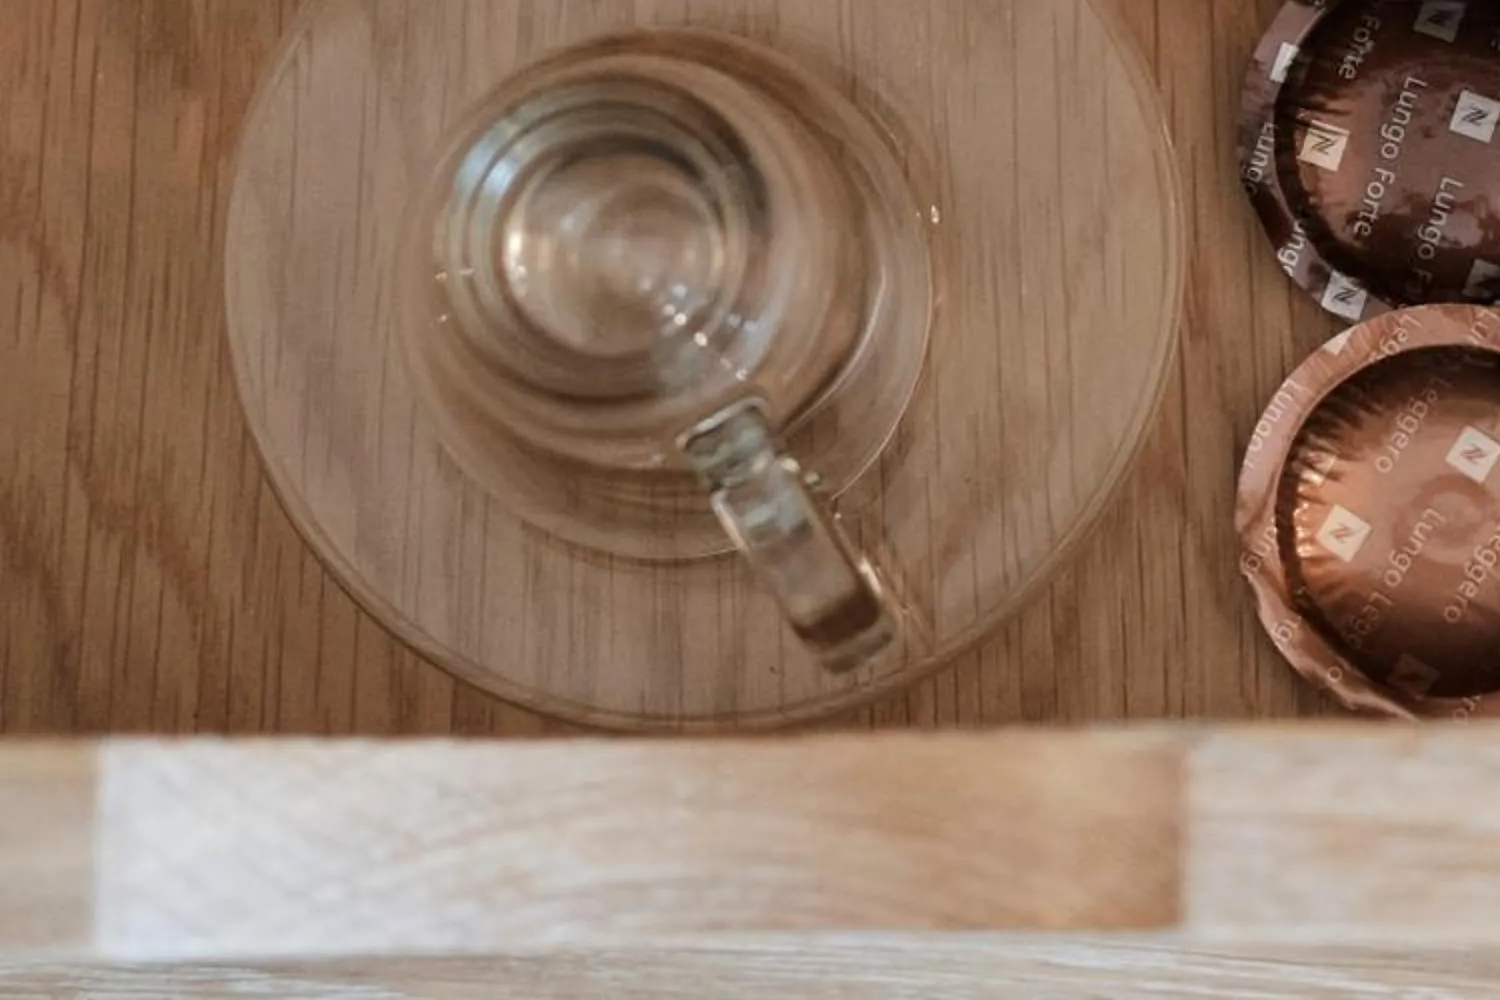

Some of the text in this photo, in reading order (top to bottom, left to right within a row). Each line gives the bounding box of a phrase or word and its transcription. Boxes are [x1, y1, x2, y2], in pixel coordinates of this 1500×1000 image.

[1338, 14, 1381, 80] Forte
[1352, 75, 1429, 236] Lungo Forte
[1416, 176, 1466, 261] Lungo
[1384, 506, 1448, 588] Lungo
